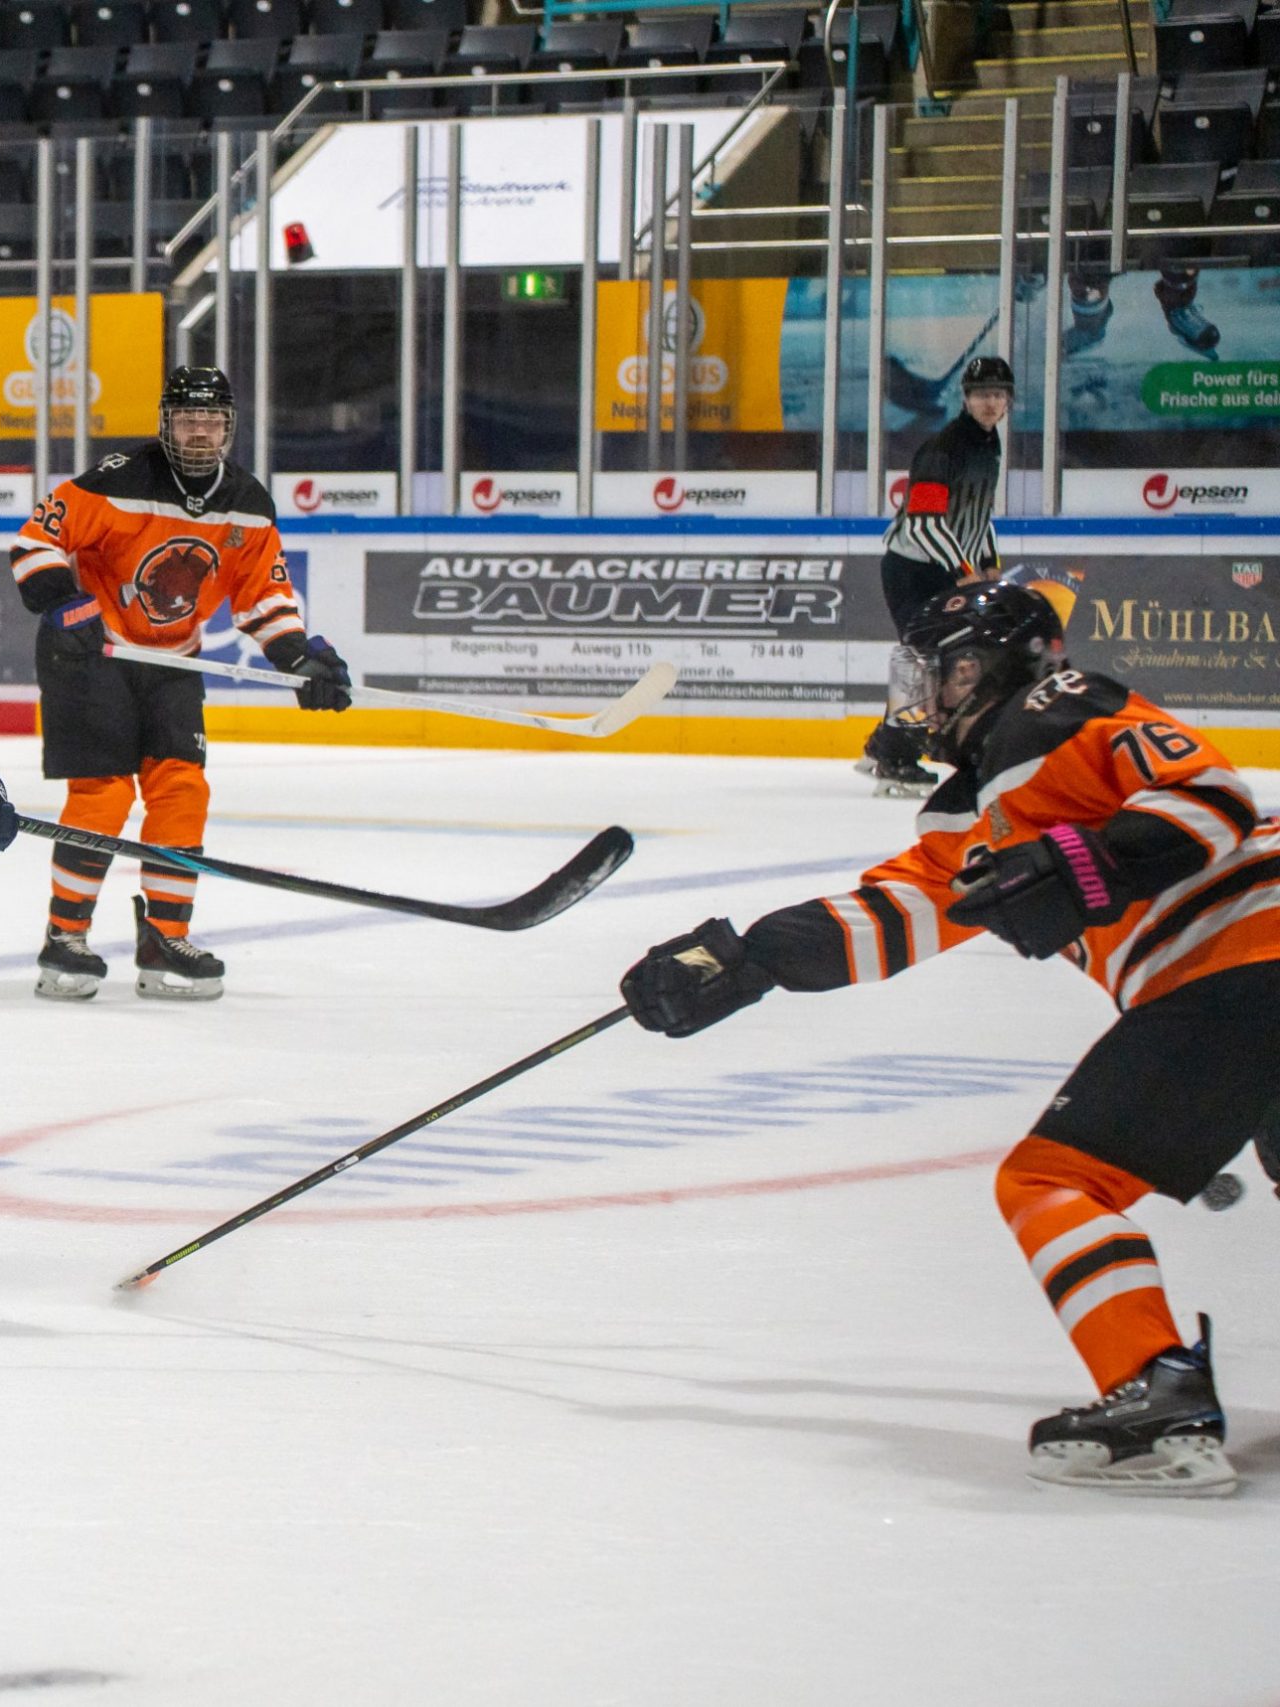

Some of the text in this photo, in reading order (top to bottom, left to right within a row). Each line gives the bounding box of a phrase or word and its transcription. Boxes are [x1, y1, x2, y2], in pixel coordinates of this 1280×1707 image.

[1193, 370, 1278, 387] Power fürs
[1160, 391, 1217, 408] Frische
[1222, 394, 1250, 407] aus
[186, 495, 205, 513] 62
[420, 557, 844, 581] AUTOLACKIEREREI
[1232, 562, 1263, 573] TAG
[412, 580, 844, 625] BAUMER
[451, 638, 539, 658] Regensburg
[571, 641, 622, 659] Auweg
[1109, 719, 1203, 787] 76
